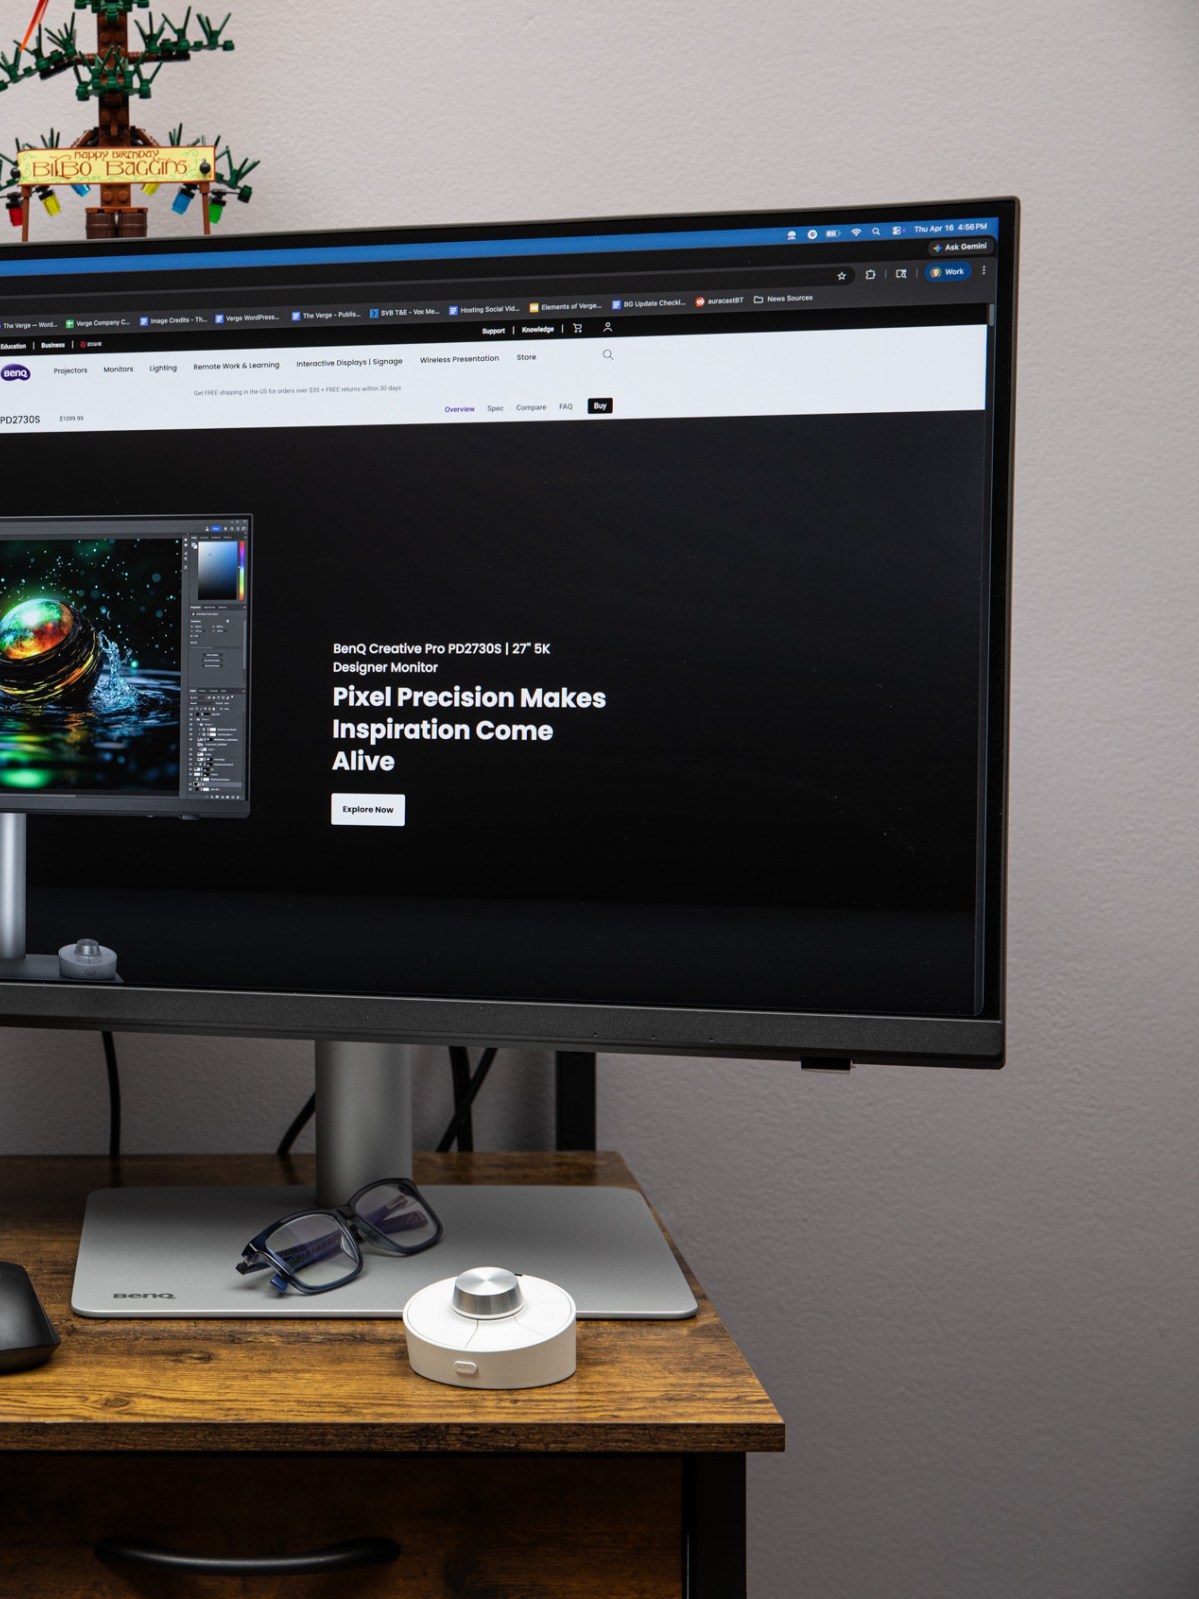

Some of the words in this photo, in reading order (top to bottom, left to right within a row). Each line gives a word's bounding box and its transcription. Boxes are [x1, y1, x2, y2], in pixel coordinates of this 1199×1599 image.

[914, 225, 928, 233] Thu
[929, 224, 943, 233] Apr
[944, 224, 954, 232] 16
[958, 223, 975, 231] 4:56
[975, 222, 988, 230] PM
[944, 243, 959, 251] Ask
[960, 242, 987, 250] Gemini
[945, 267, 964, 275] Work
[314, 312, 331, 320] Verge
[76, 320, 92, 328] Verge
[94, 319, 119, 327] Company
[482, 327, 505, 335] Support
[522, 325, 555, 334] Knowledge
[0, 342, 27, 350] Education
[41, 341, 65, 349] Business
[420, 356, 451, 364] Wireless
[452, 354, 499, 363] Presentation
[517, 353, 537, 361] Store
[193, 363, 221, 371] Remote
[222, 362, 240, 370] Work
[249, 361, 280, 370] Learning
[296, 359, 337, 368] Interactive
[339, 359, 367, 368] Displays
[372, 357, 403, 366] Signage
[53, 367, 88, 375] Projectors
[103, 365, 133, 373] Monitors
[149, 364, 177, 373] Lighting
[219, 389, 243, 397] shipping
[444, 405, 475, 413] Overview
[487, 405, 504, 413] Spec
[516, 403, 547, 412] Compare
[593, 402, 607, 411] Buy
[0, 415, 40, 424] PD2730S
[333, 643, 366, 655] BenQ
[369, 643, 423, 655] Creative
[425, 643, 445, 655] Pro
[448, 643, 502, 655] PD2730S
[512, 642, 532, 654] 27"
[534, 643, 551, 654] 5K
[333, 662, 388, 676] Designer
[390, 661, 438, 673] Monitor
[333, 685, 391, 707] Pixel
[397, 685, 515, 708] Precision
[521, 687, 607, 709] Makes
[332, 717, 470, 746] Inspiration
[476, 720, 554, 741] Come
[331, 749, 395, 771] Alive
[343, 805, 373, 815] Explore
[375, 806, 394, 814] Now
[113, 1292, 176, 1300] BenQ
